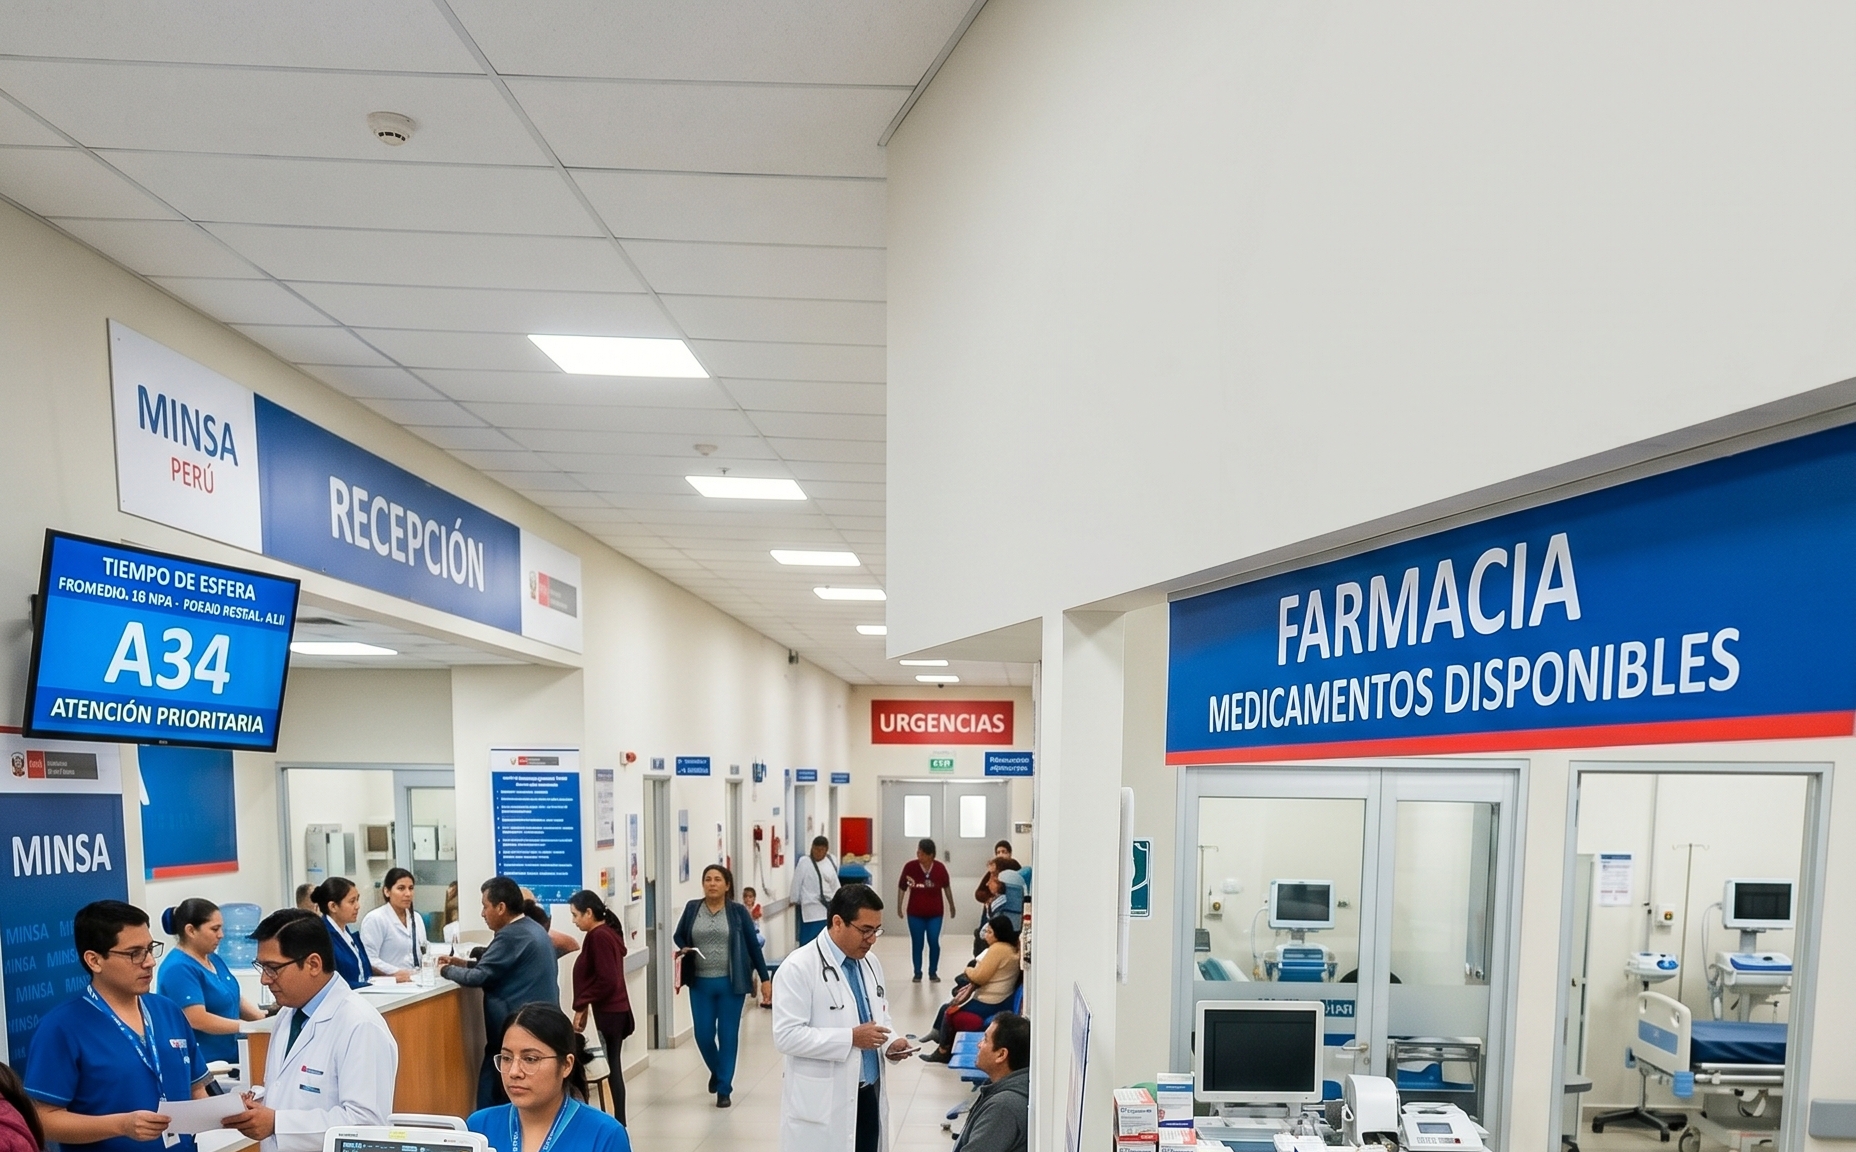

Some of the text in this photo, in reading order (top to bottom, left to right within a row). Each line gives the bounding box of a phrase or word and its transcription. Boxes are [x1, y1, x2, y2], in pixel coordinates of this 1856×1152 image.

[137, 384, 239, 466] MINSA
[170, 456, 215, 494] PERÚ
[328, 475, 485, 592] RECEPCIÓN
[103, 557, 256, 600] TIEMPO DE ESFERA
[132, 590, 146, 603] 16
[148, 592, 172, 608] NPA
[1277, 532, 1582, 666] FARMACIA
[103, 621, 231, 695] A34
[1208, 627, 1740, 733] MEDICAMENTOS DISPONIBLES
[50, 697, 264, 733] ATENCIÓN PRIORITARIA
[879, 713, 1005, 734] URGENCIAS
[12, 833, 112, 877] MINSA
[6, 922, 49, 946] MINSA
[16, 981, 54, 1003] MINSA
